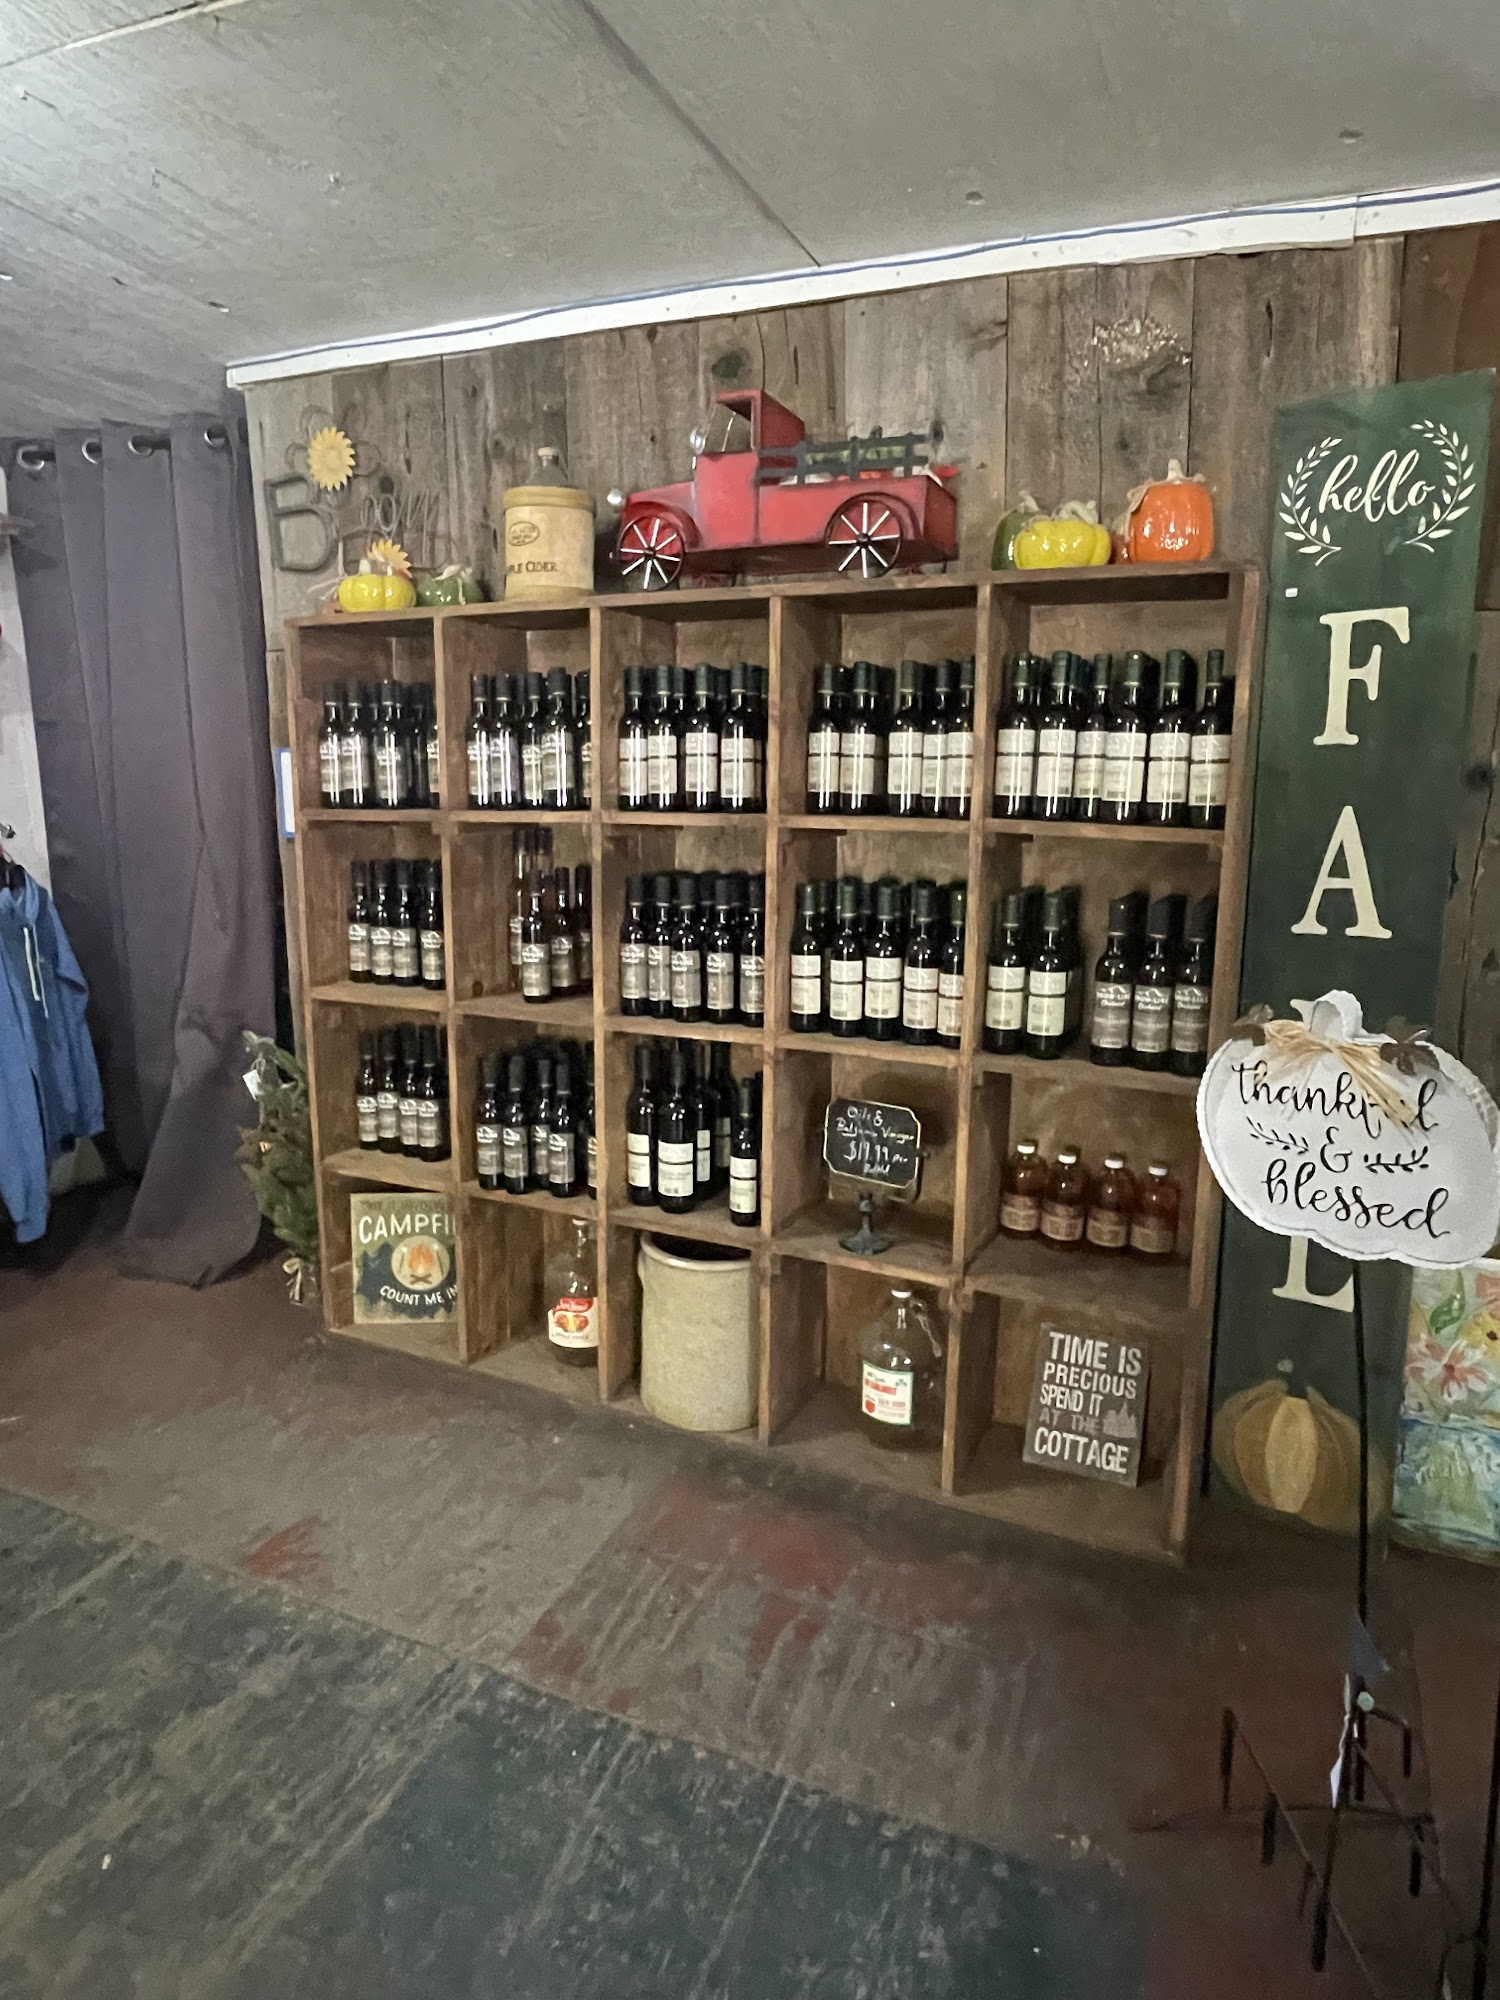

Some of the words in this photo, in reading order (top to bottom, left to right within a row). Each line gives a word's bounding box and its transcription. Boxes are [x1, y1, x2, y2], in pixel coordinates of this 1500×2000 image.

[1318, 449, 1436, 524] hello
[525, 560, 558, 573] CIDER
[1231, 1060, 1439, 1139] thankfl
[1320, 1126, 1353, 1173] &
[1261, 1158, 1451, 1239] blessed
[380, 1285, 420, 1306] COUNT
[424, 1292, 443, 1306] ME
[1049, 1331, 1109, 1371] TIME
[1118, 1346, 1142, 1377] IS
[1039, 1383, 1084, 1413] SPEND
[1089, 1393, 1104, 1417] IT
[1043, 1361, 1137, 1400] PRECIOUS
[1039, 1407, 1061, 1426] AT
[1071, 1414, 1100, 1434] THE
[1034, 1426, 1129, 1475] COTTAGE
